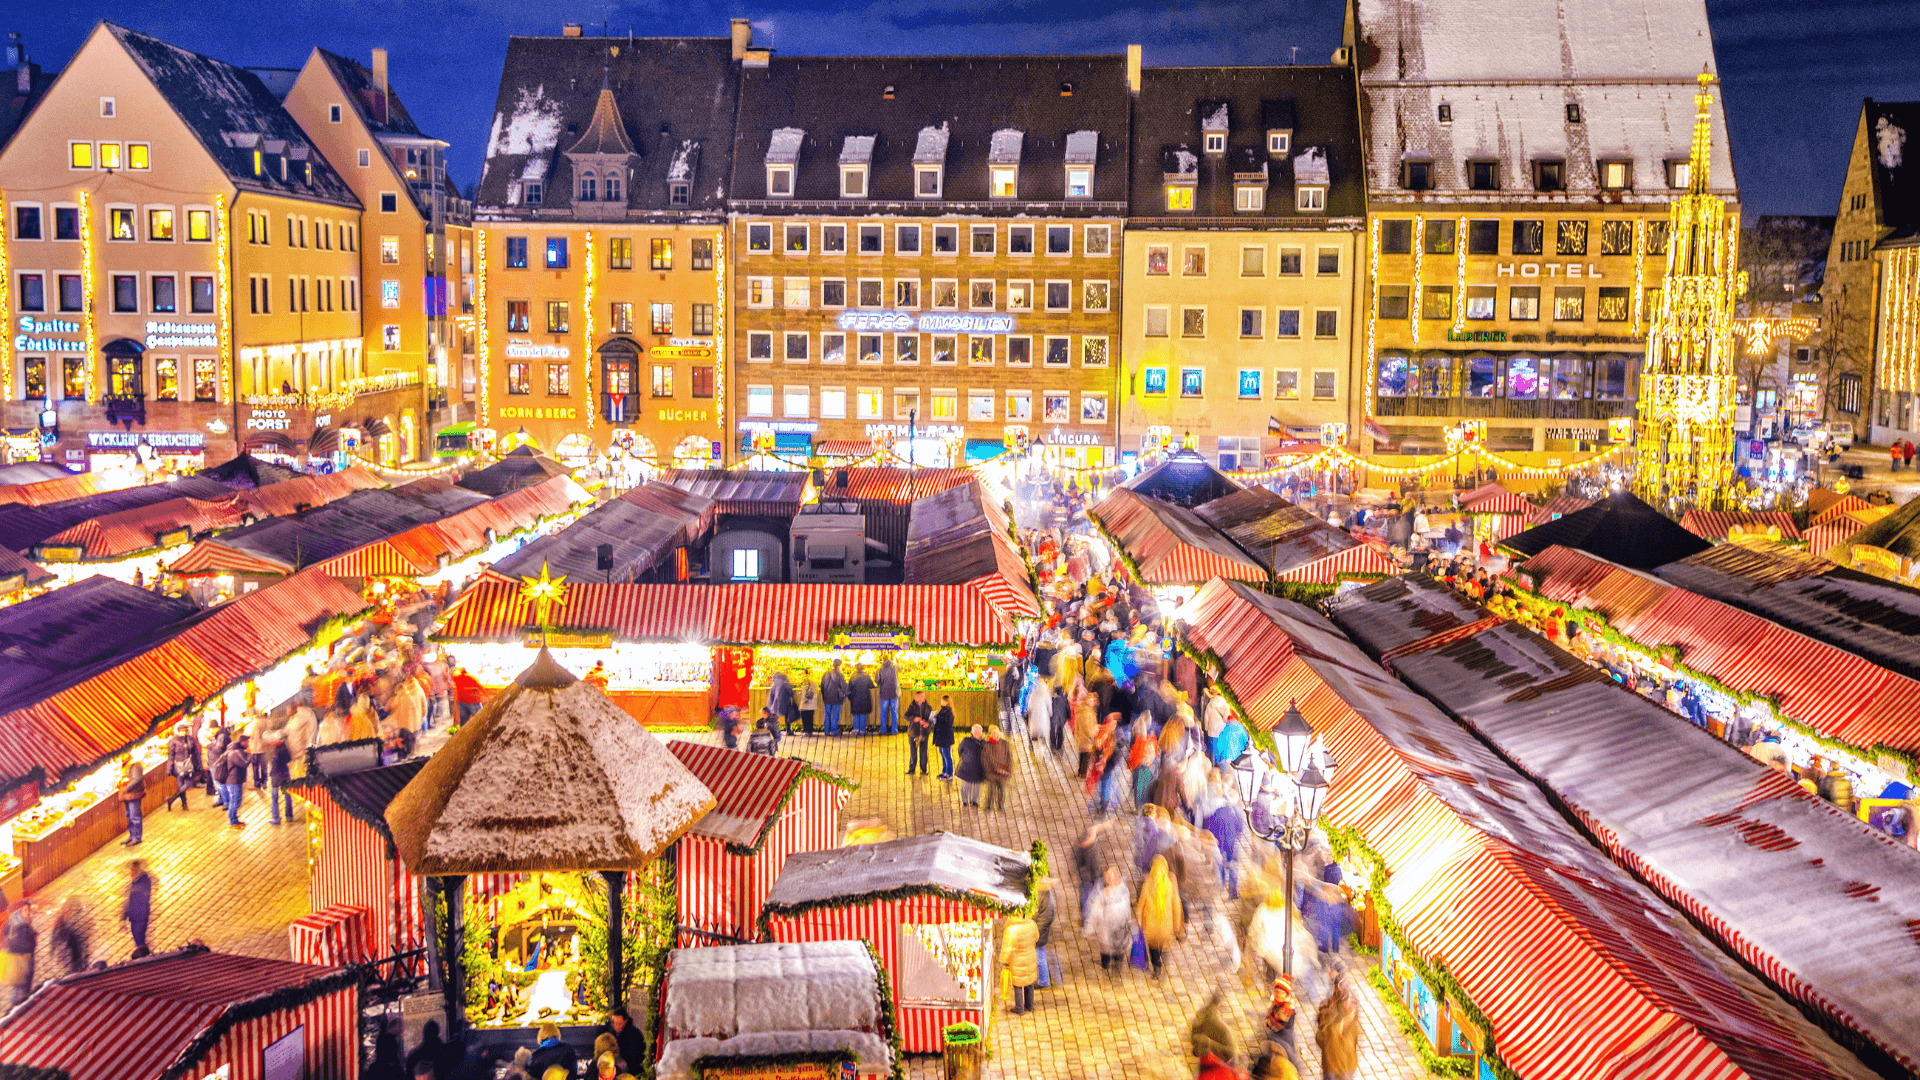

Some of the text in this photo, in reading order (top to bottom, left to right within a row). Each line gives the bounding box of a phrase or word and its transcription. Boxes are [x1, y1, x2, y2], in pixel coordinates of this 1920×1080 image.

[1497, 263, 1602, 278] HOTEL
[19, 316, 80, 334] Spalter
[145, 322, 217, 335] Restaurant
[920, 316, 1011, 331] IMMOBILIEN
[14, 335, 86, 352] Edelbiere
[252, 410, 286, 419] PHOTO
[500, 407, 576, 419] KORN & BERG
[659, 409, 707, 421] BÜCHER
[247, 419, 291, 430] PORST
[88, 433, 139, 446] WICKLEIN
[1047, 430, 1099, 445] LINCURA
